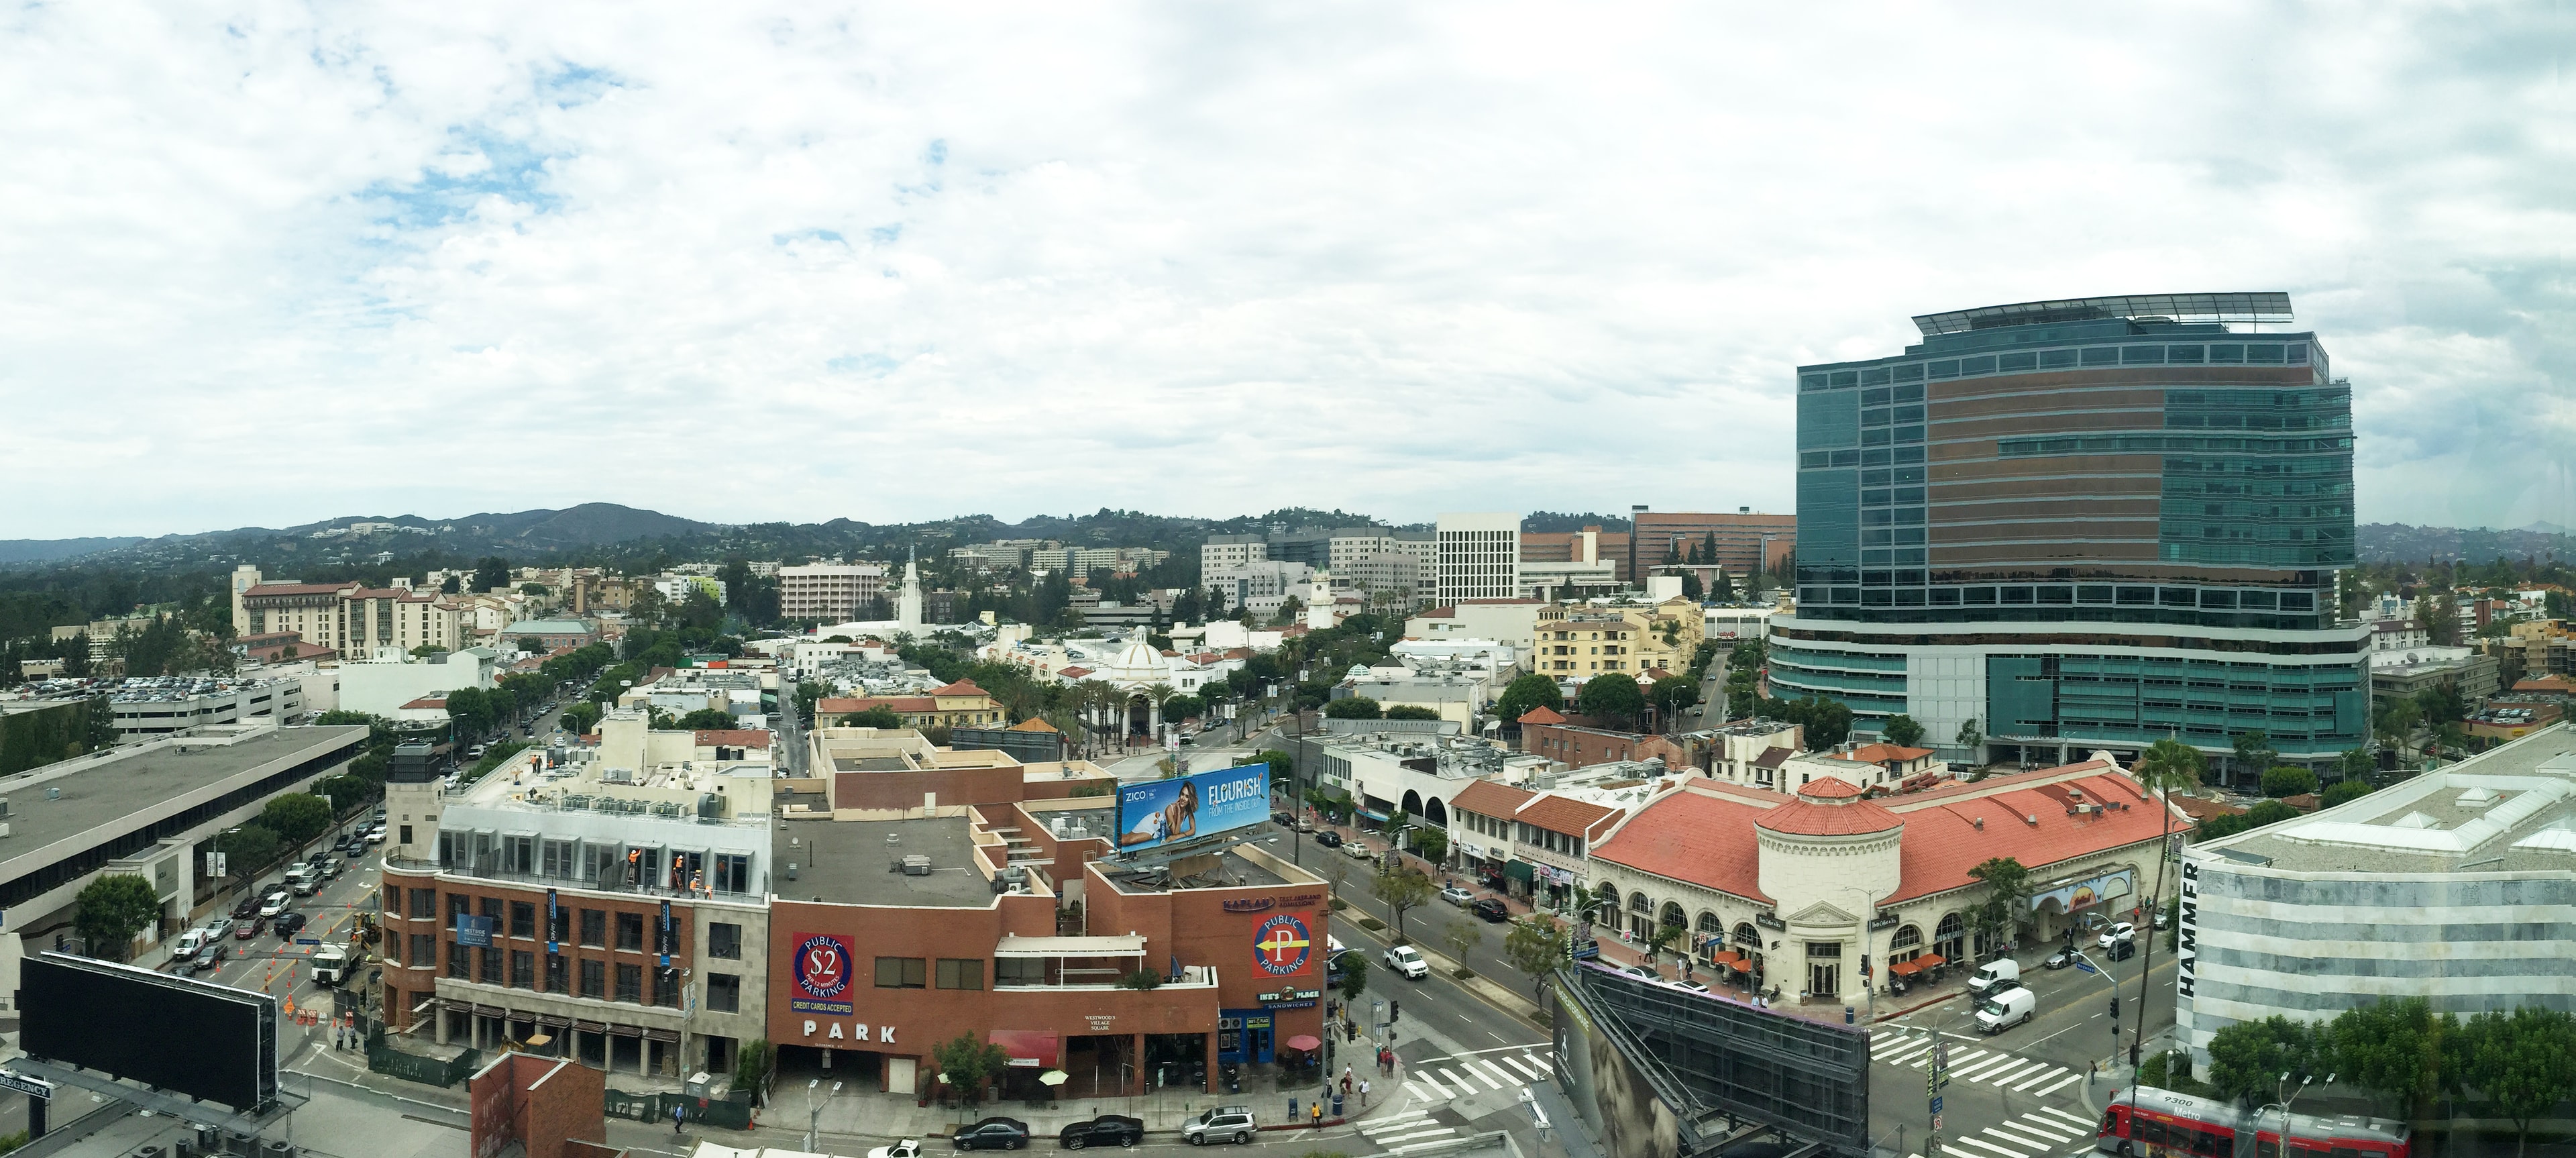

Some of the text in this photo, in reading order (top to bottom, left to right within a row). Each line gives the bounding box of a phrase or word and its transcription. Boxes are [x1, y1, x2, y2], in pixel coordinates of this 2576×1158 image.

[1126, 790, 1146, 802] ZICO
[1208, 776, 1261, 805] FLOURISH
[1209, 797, 1261, 818] FROM THE INSIDE OUT
[1224, 897, 1269, 908] KAPLAN
[1265, 915, 1301, 930] PUBLIC
[2180, 862, 2198, 998] HAMMER
[805, 936, 843, 953] PUBLIC
[1275, 930, 1293, 961] P
[810, 948, 837, 977] $2
[1260, 957, 1304, 975] PARKING
[800, 979, 845, 998] PARKING
[806, 973, 814, 984] PER
[820, 975, 840, 988] MINUTES
[793, 1002, 852, 1013] CREDIT CARDS ACCEPTED
[804, 1020, 896, 1043] PARK
[0, 1076, 48, 1096] REGENCY
[2164, 1096, 2194, 1106] 9300
[2174, 1107, 2200, 1121] Metro
